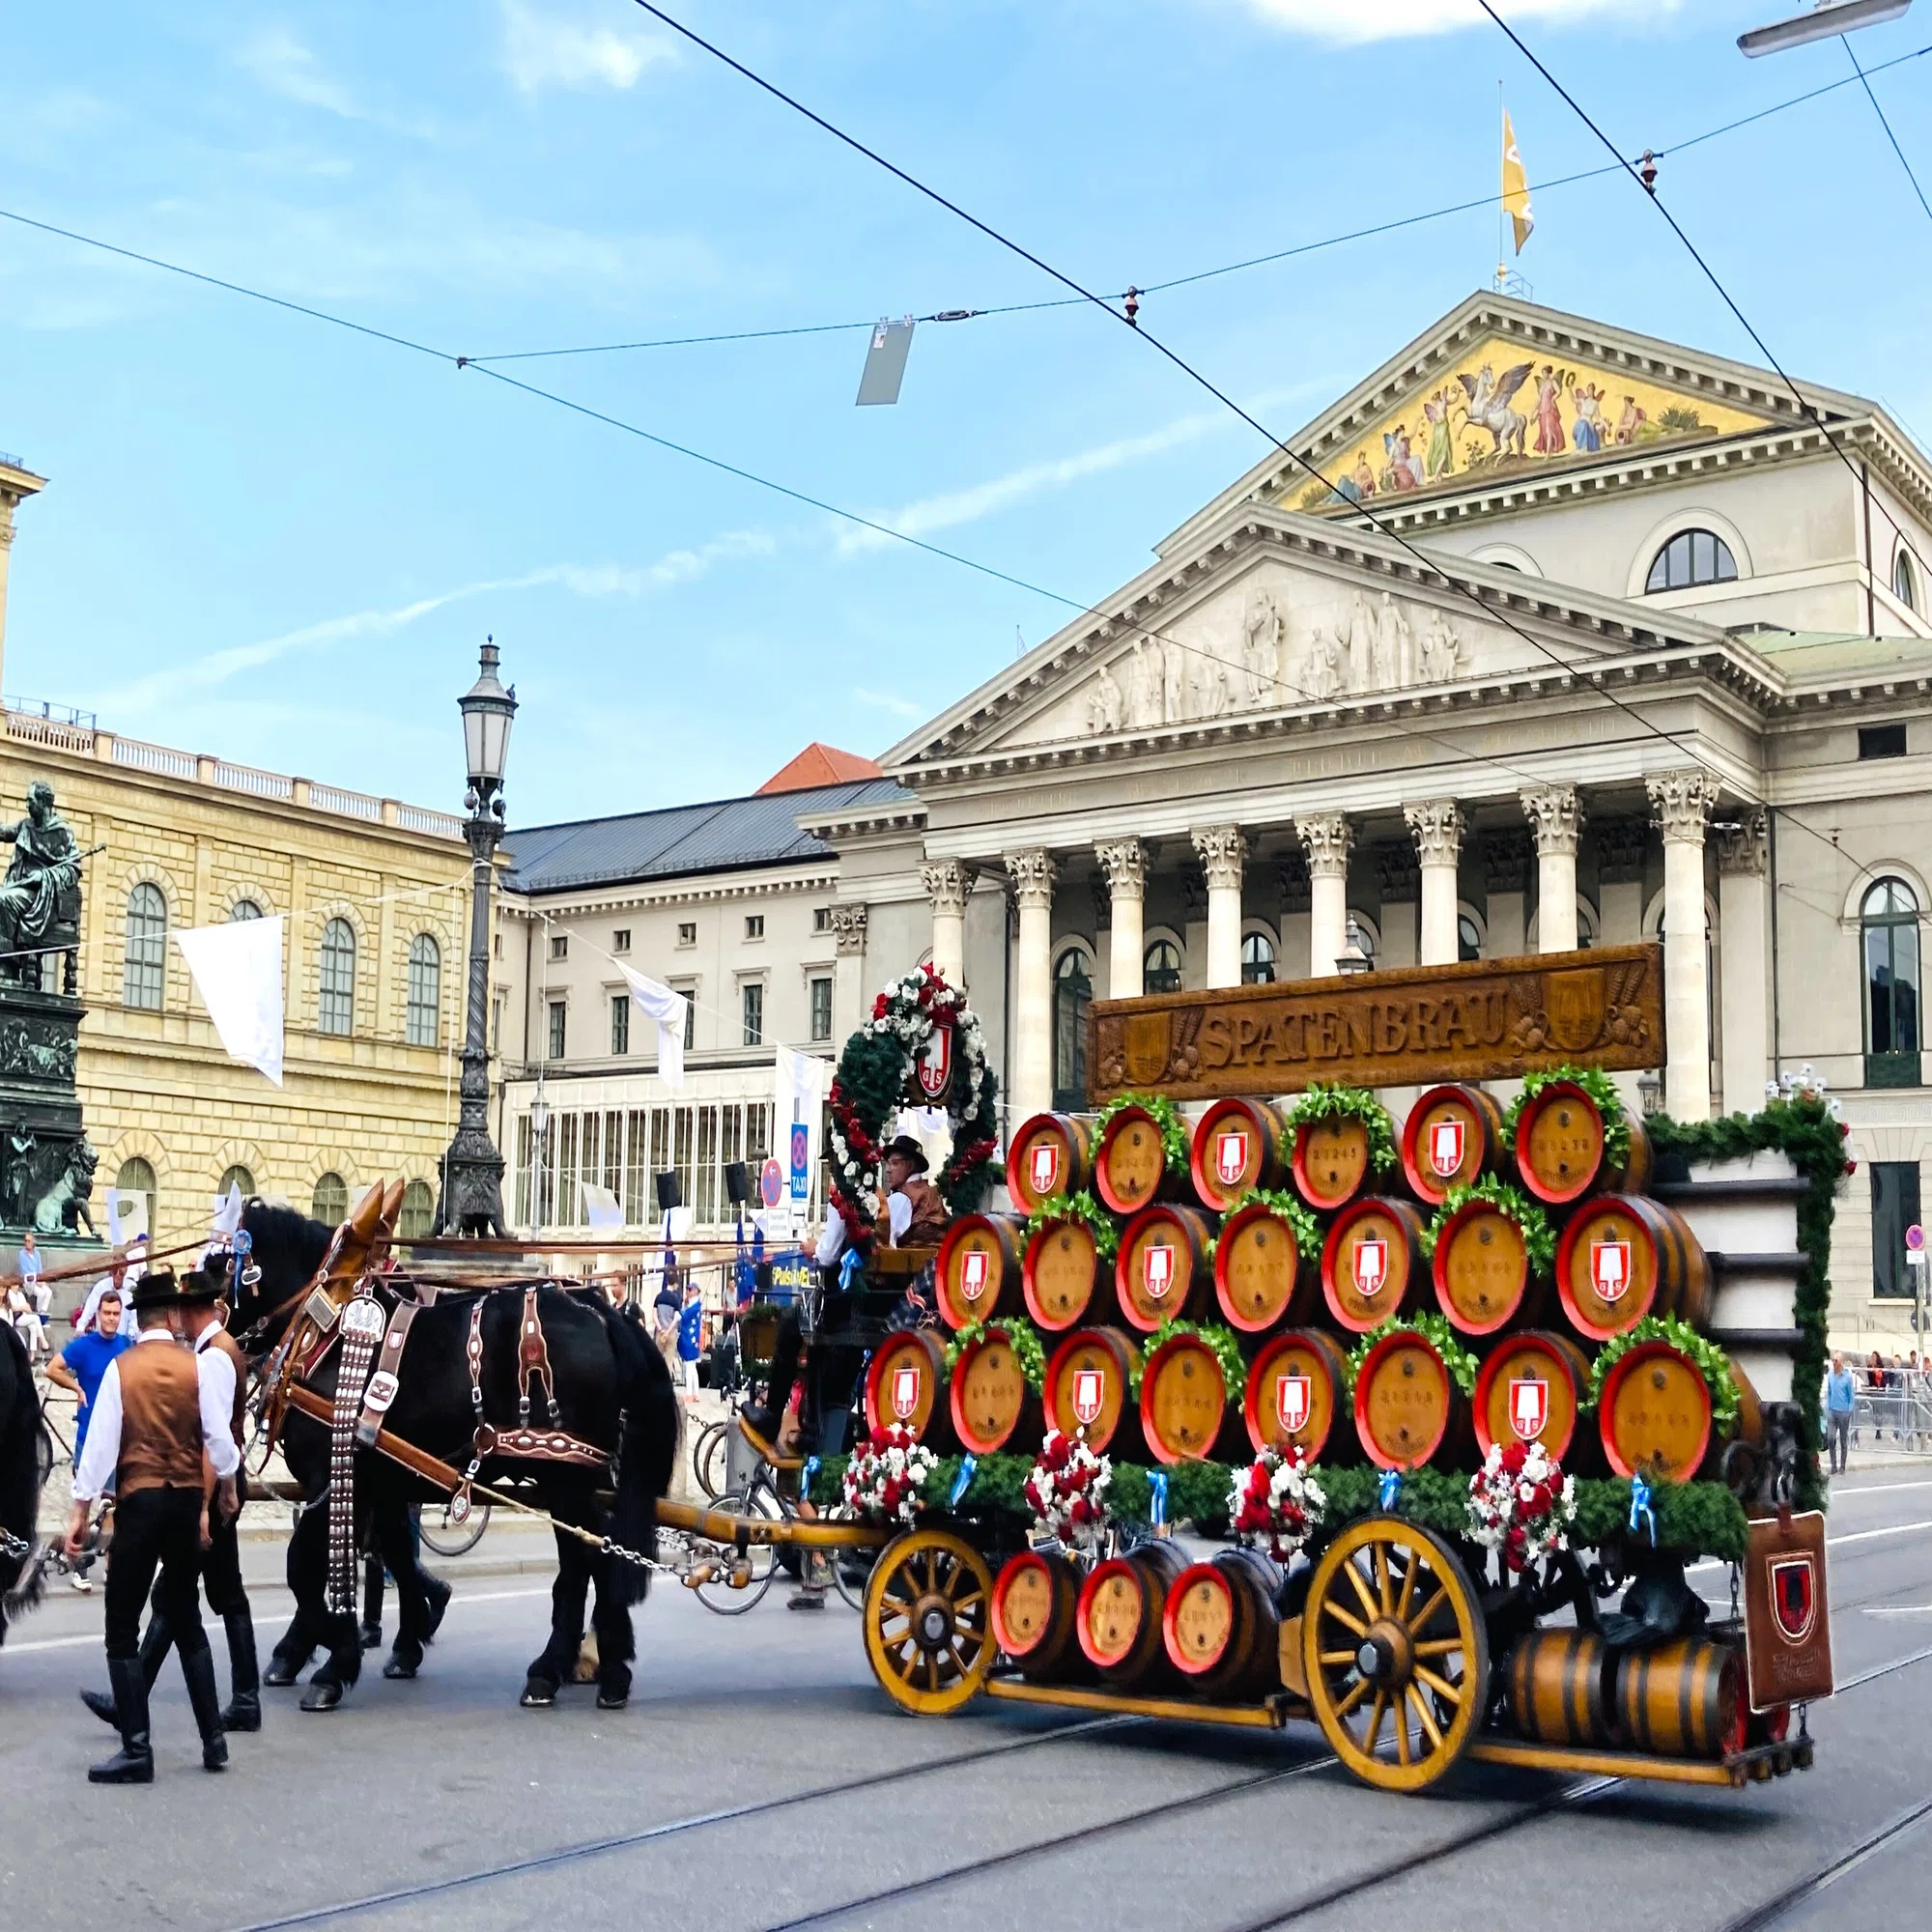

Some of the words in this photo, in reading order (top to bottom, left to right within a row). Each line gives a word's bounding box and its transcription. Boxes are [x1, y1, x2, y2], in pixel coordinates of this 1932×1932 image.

[923, 1069, 929, 1082] G
[936, 1072, 943, 1084] S
[792, 1176, 807, 1193] TAXI
